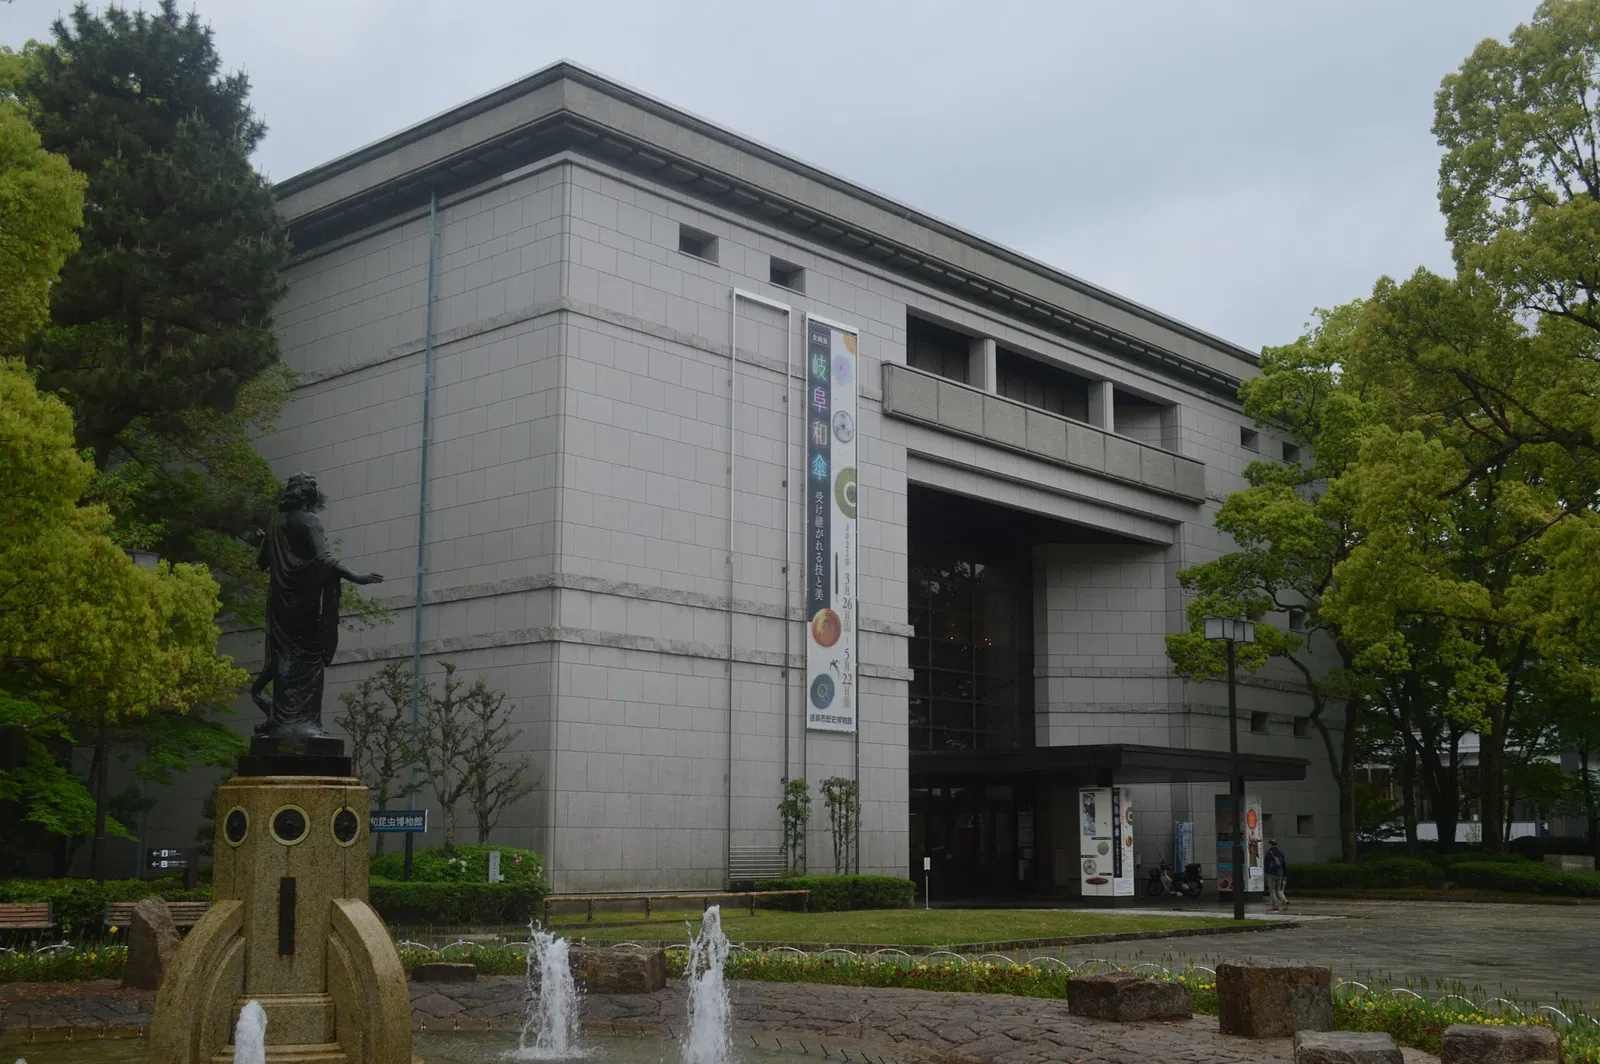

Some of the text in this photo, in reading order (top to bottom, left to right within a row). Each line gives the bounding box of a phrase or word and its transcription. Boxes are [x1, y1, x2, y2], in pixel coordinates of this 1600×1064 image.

[811, 353, 828, 481] 岐阜和傘
[814, 491, 824, 601] 受け継がれる技と美
[809, 713, 853, 726] 岐阜市歴史博物館
